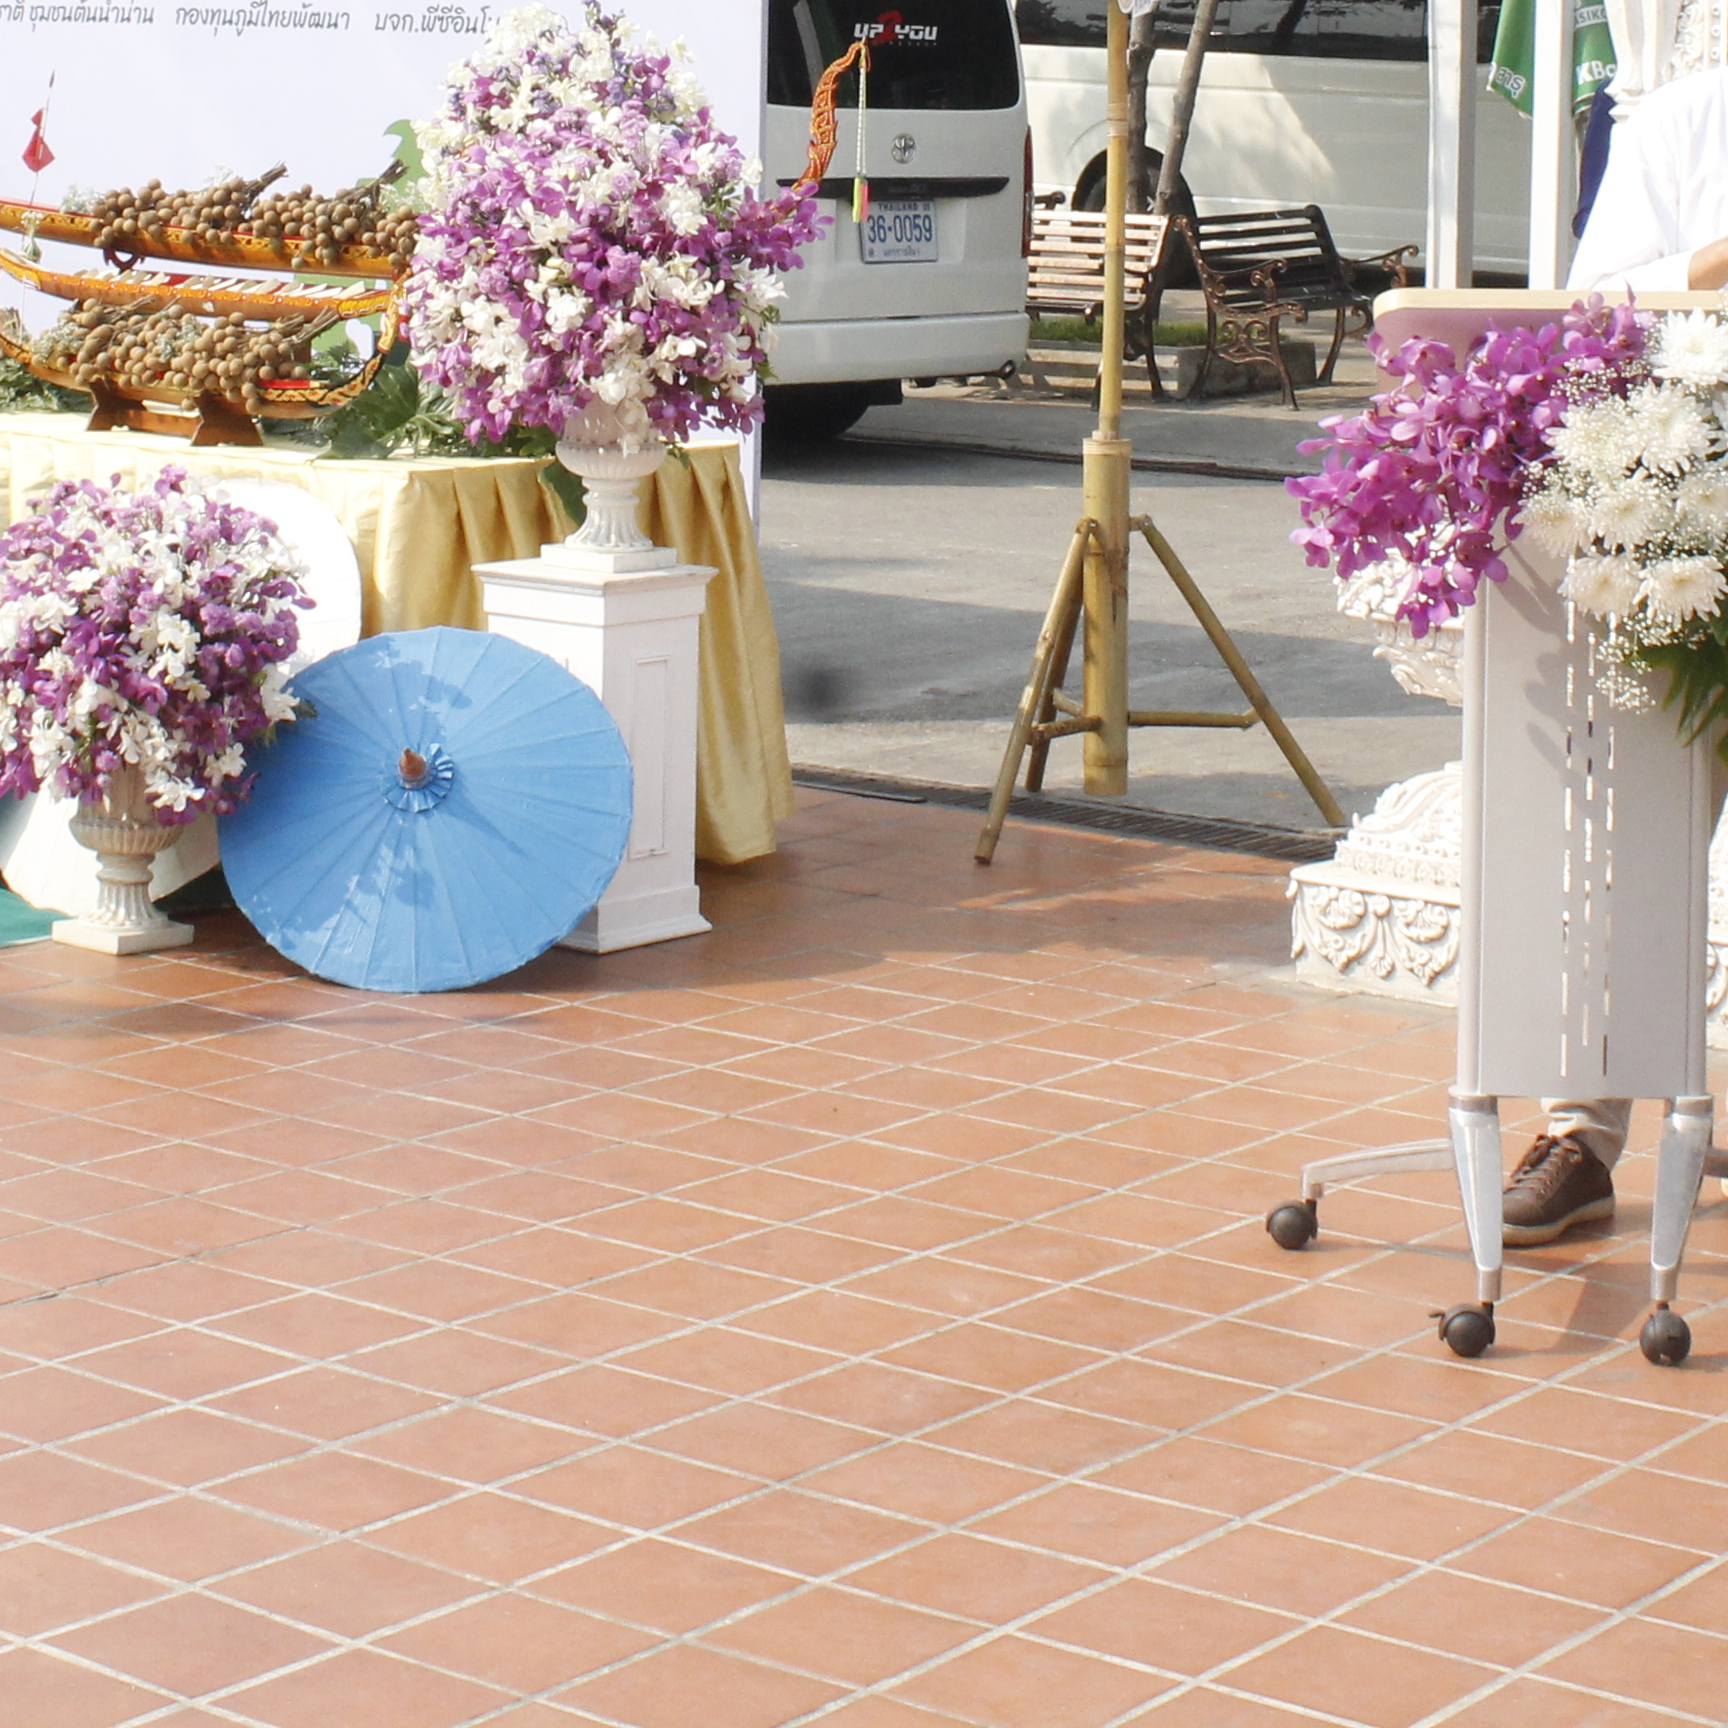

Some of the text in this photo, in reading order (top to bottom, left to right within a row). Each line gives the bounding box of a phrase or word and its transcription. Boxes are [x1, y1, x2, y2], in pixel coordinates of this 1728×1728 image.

[375, 4, 501, 35] บจก.พีซีอินโ
